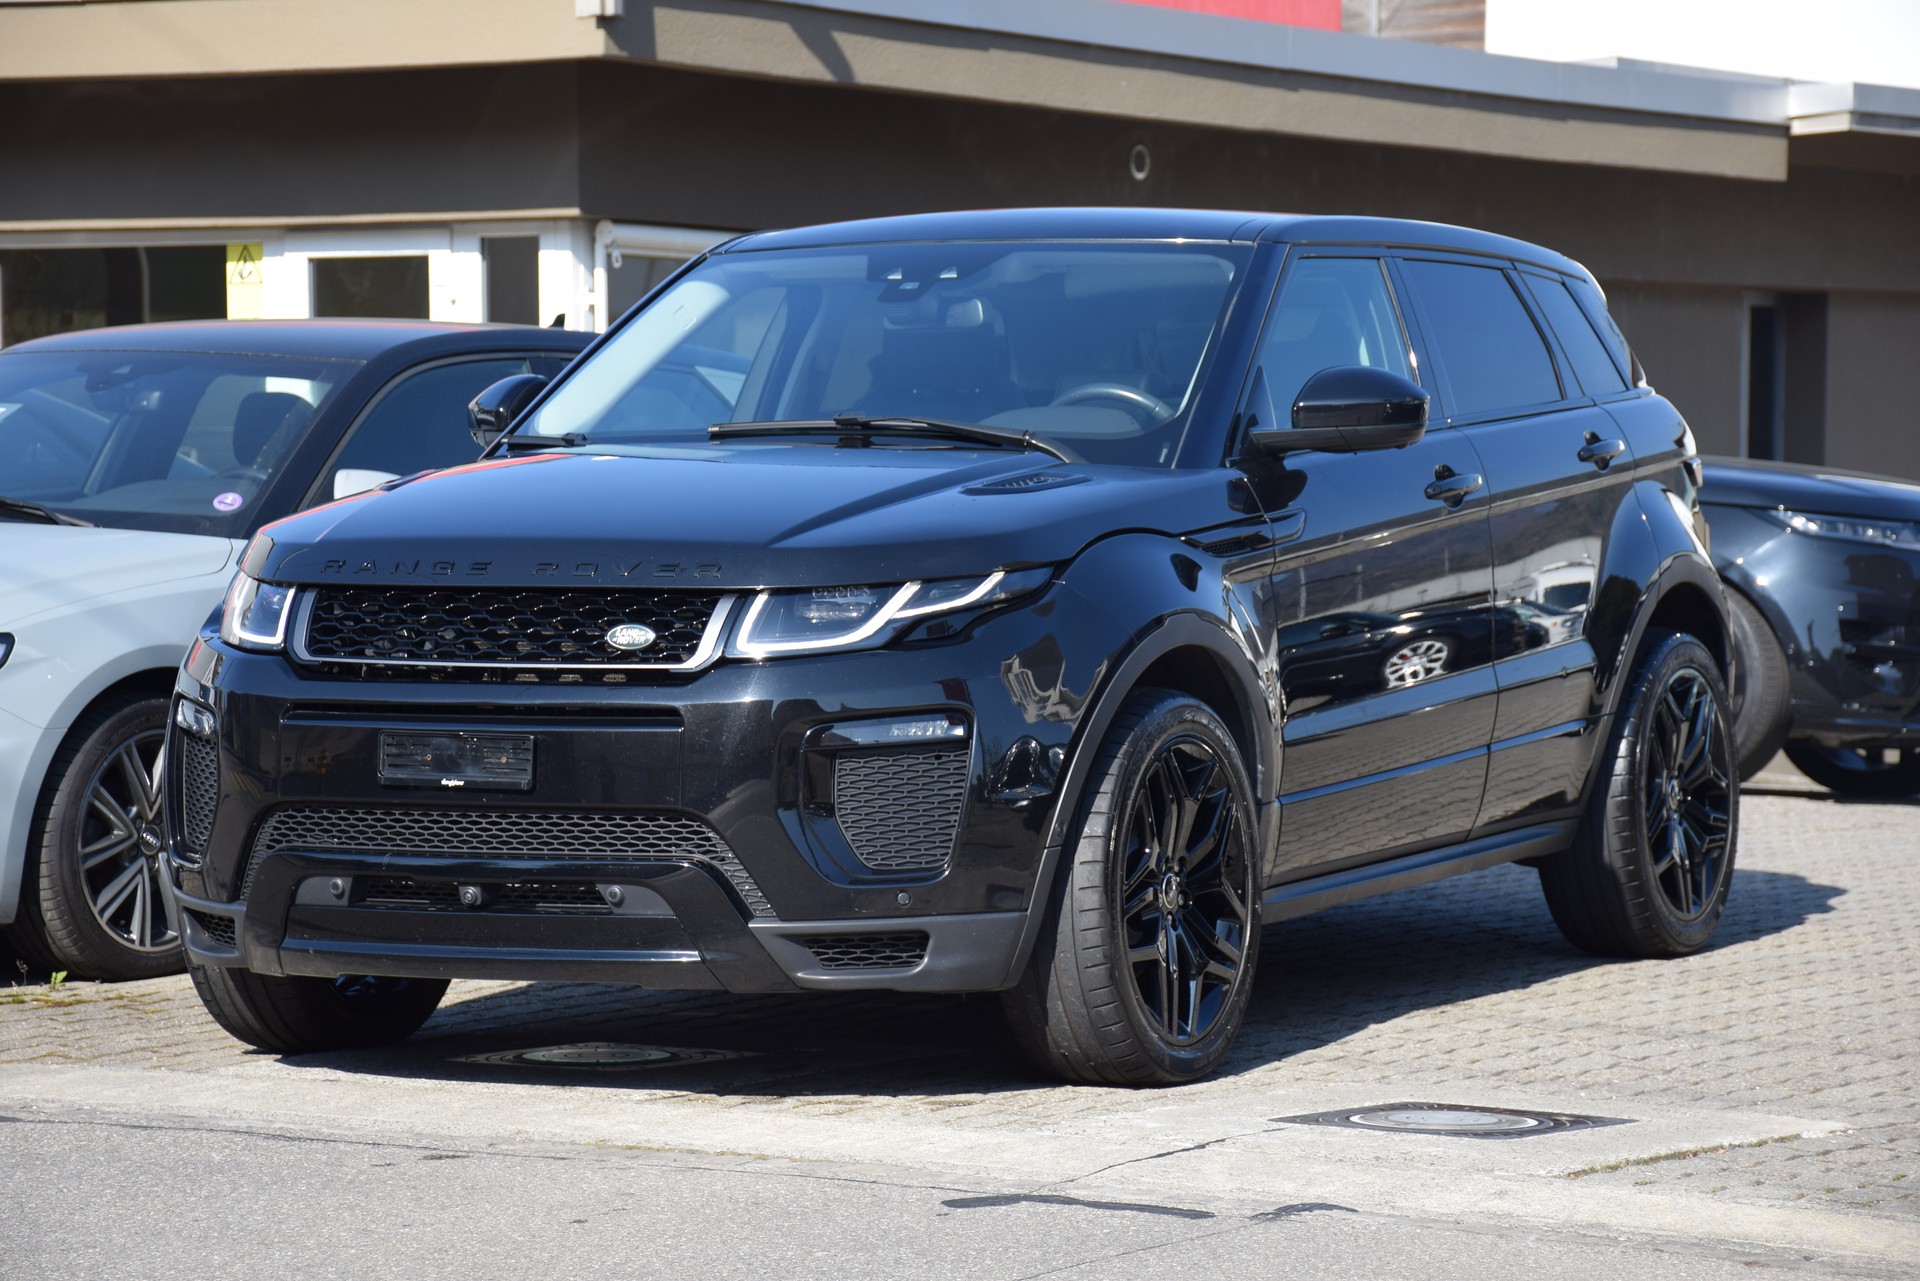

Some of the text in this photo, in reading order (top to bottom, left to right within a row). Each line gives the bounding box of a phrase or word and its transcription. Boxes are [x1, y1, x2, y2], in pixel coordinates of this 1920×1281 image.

[320, 557, 722, 578] RANGE ROVER
[615, 628, 641, 637] LAND
[616, 636, 646, 645] ROVER
